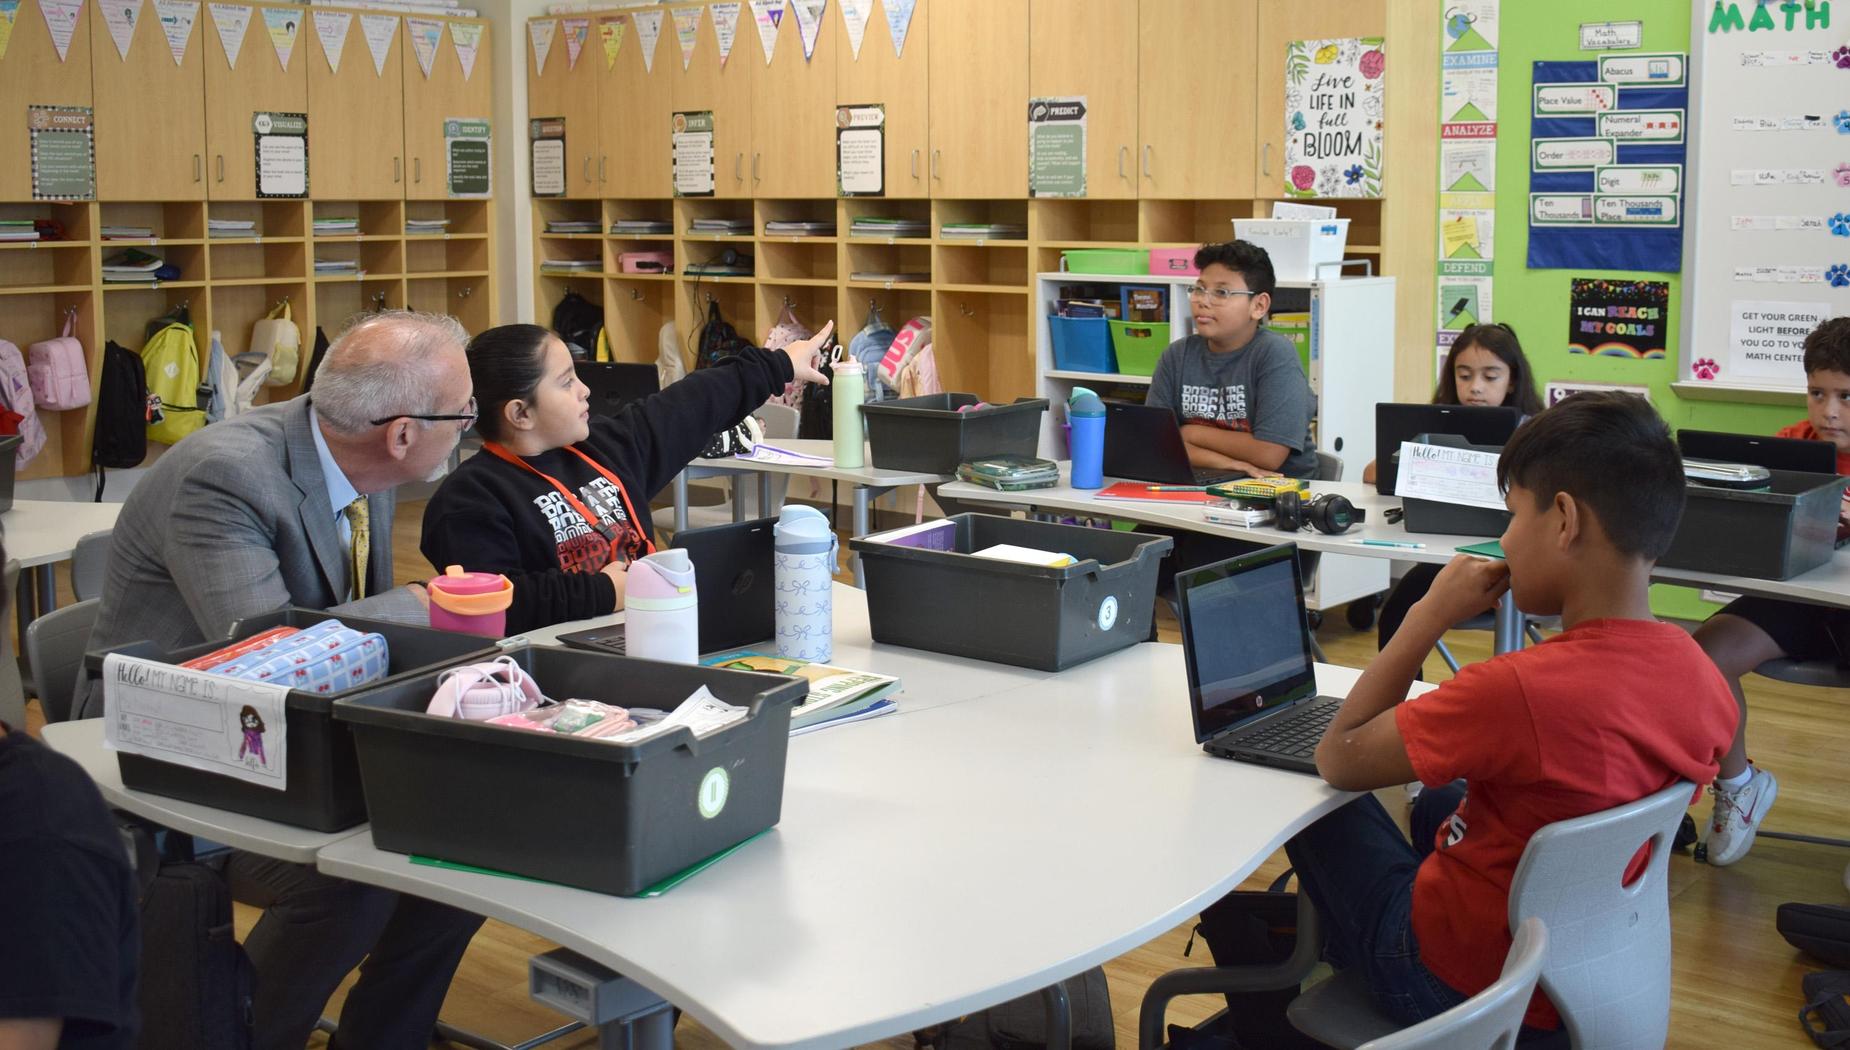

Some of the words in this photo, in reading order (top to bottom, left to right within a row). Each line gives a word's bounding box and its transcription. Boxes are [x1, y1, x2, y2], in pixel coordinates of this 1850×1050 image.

[1709, 1, 1830, 33] MATH
[1595, 29, 1617, 37] Math
[1444, 54, 1497, 66] EXAMINE
[1605, 66, 1633, 75] Abacus
[1309, 94, 1334, 111] LIFE
[1340, 92, 1355, 110] IN
[1539, 97, 1558, 105] Place
[1562, 96, 1582, 104] Value
[1050, 106, 1079, 116] PREDICT
[53, 115, 86, 124] CONNECT
[1317, 112, 1348, 130] full
[1605, 115, 1641, 124] Numeral
[1444, 124, 1494, 136] ANALYZE
[1605, 129, 1643, 138] Expander
[1304, 130, 1362, 159] BLOOM
[1539, 151, 1564, 160] Order
[1601, 177, 1620, 187] Digit
[1539, 199, 1554, 207] Ten
[1601, 199, 1617, 207] Ten
[1620, 199, 1663, 208] Thousands
[1539, 210, 1580, 219] Thousands
[1601, 212, 1622, 221] Place
[1443, 262, 1487, 273] DEFEND
[1577, 306, 1582, 315] I
[1584, 306, 1606, 316] CAN
[1607, 305, 1659, 319] REACH
[1742, 312, 1759, 320] GET
[1761, 313, 1786, 321] YOUR
[1788, 314, 1818, 322] GREEN
[1581, 320, 1603, 333] MY
[1605, 322, 1654, 336] GOALS
[1748, 326, 1775, 334] LIGHT
[1777, 326, 1810, 336] BEFORE
[1740, 339, 1760, 347] YOU
[1762, 340, 1775, 348] GO
[1778, 340, 1790, 348] TO
[1746, 352, 1772, 361] MATH
[1774, 353, 1804, 363] CENTE
[1412, 445, 1440, 460] Hello!
[1105, 605, 1111, 620] 3
[117, 662, 150, 686] Hello!
[152, 670, 167, 689] MY
[170, 674, 198, 696] NAME
